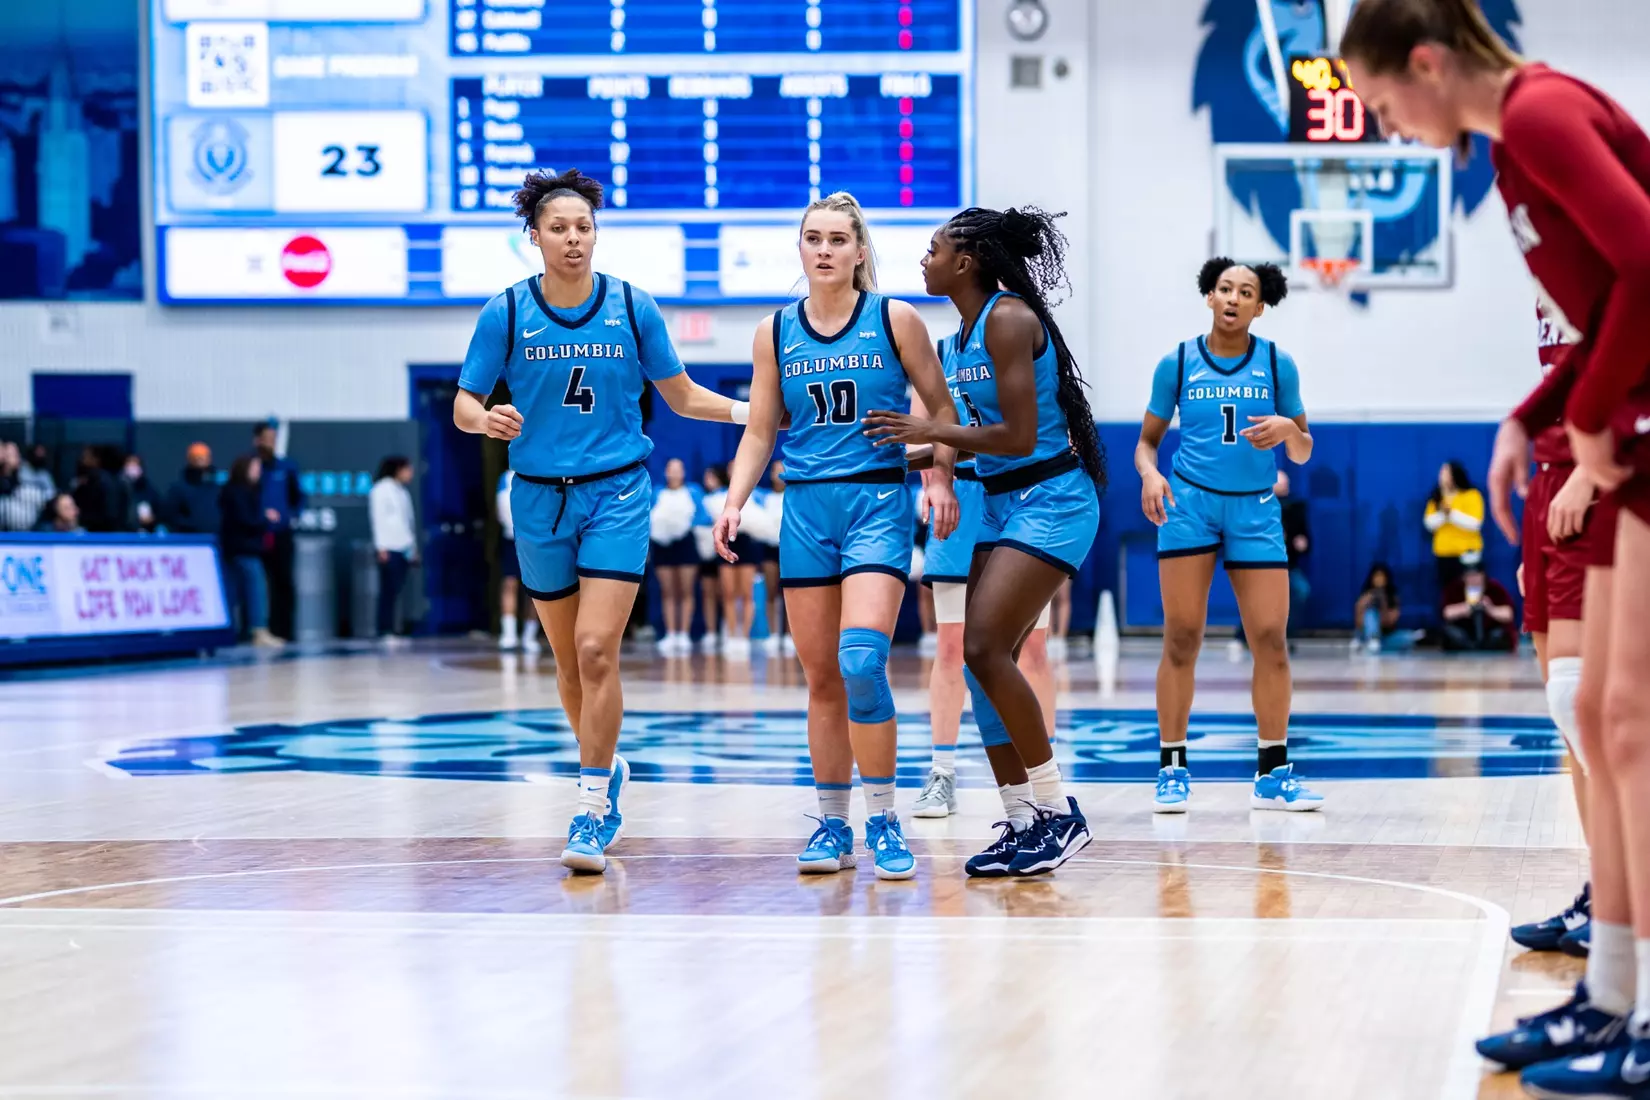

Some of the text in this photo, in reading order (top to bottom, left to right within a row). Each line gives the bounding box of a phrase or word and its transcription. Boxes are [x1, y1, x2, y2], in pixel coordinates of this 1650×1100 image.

[1307, 88, 1364, 141] 30
[321, 145, 381, 176] 23
[525, 343, 625, 361] COLUMBIA
[784, 354, 884, 378] COLUMBIA
[561, 365, 595, 414] 4
[806, 379, 857, 427] 10
[1188, 386, 1269, 400] COLUMBIA
[1220, 404, 1237, 445] 1
[1, 556, 46, 594] ONE
